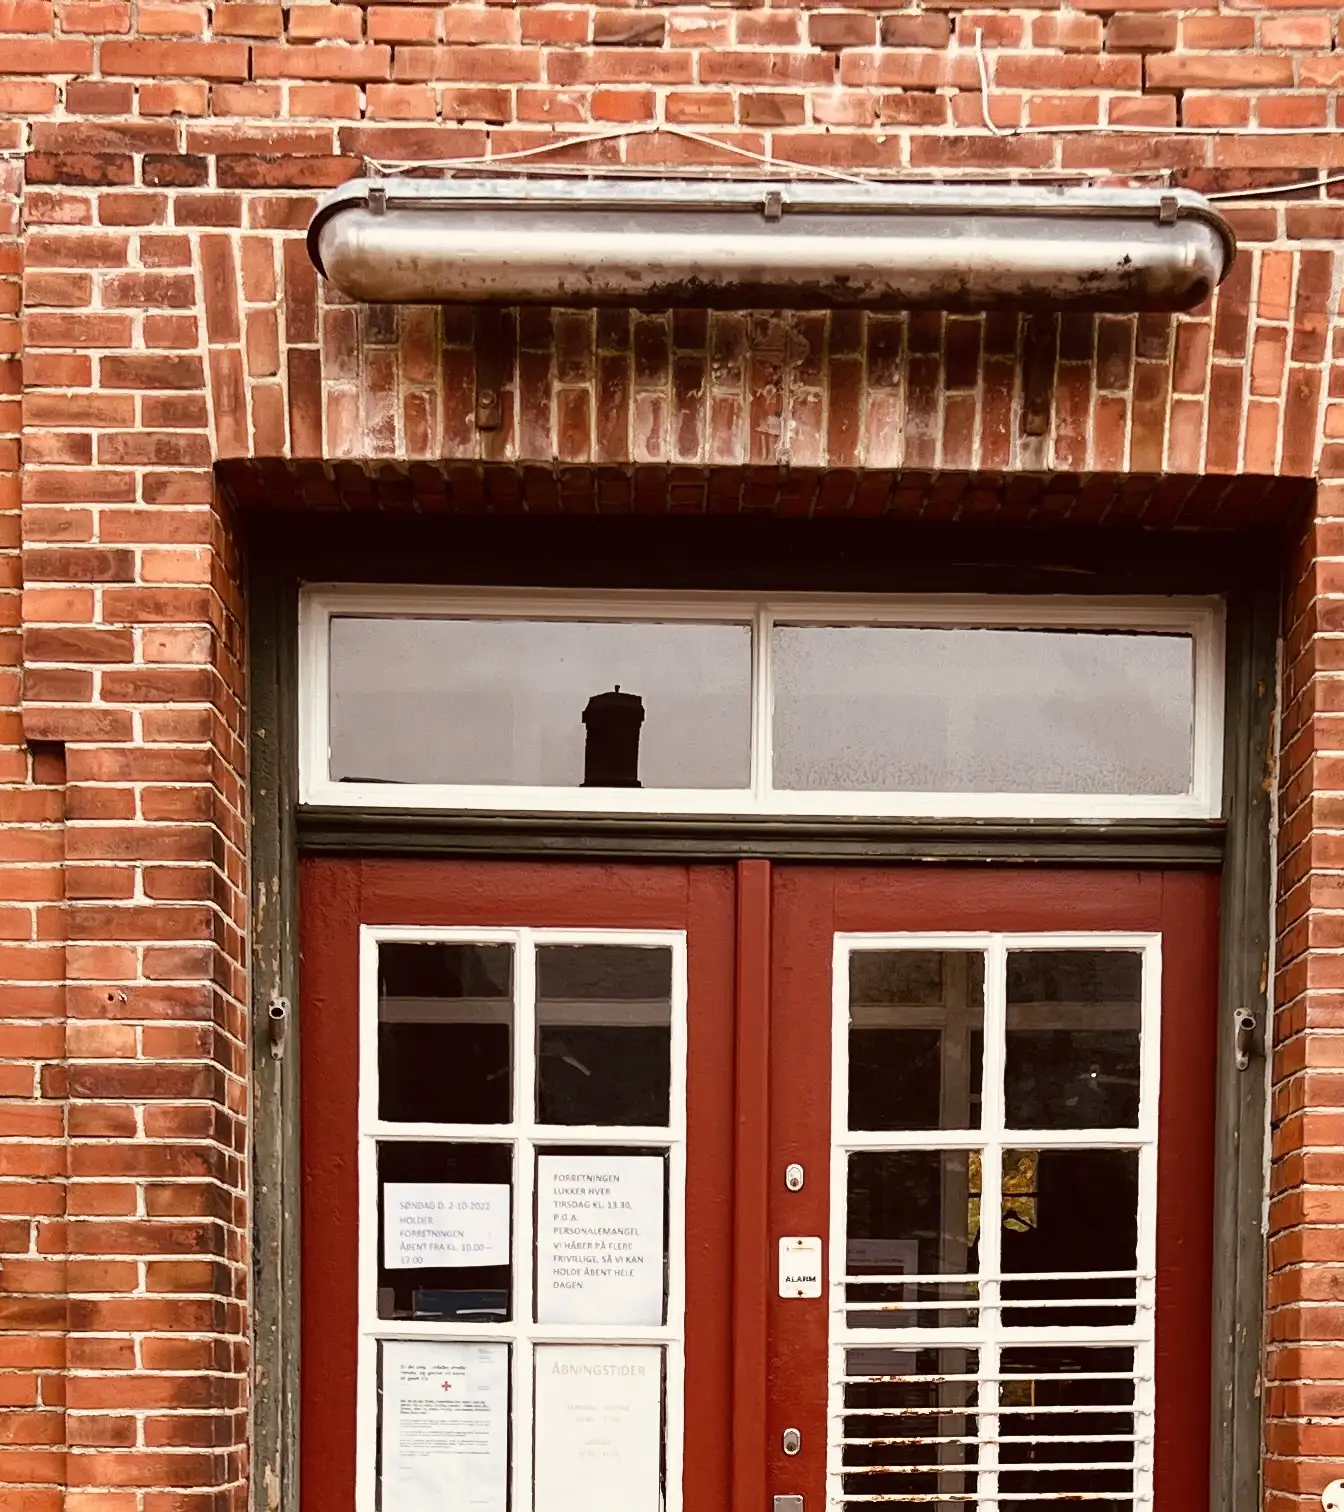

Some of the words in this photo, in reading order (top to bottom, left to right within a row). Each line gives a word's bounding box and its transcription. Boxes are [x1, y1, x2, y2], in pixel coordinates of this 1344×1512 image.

[553, 1174, 620, 1183] FORRETNINGEN
[553, 1187, 586, 1196] LUKKER
[588, 1188, 611, 1196] HVER
[399, 1201, 435, 1210] SØNDAG
[553, 1200, 590, 1209] TIRSDAG
[399, 1216, 434, 1225] HOLDER
[399, 1230, 465, 1238] FORRETNINGEN
[399, 1241, 427, 1251] ÅBENT
[429, 1244, 445, 1252] FRA
[595, 1241, 606, 1250] PÅ
[608, 1243, 633, 1251] FLERE
[601, 1254, 612, 1263] SÅ
[553, 1268, 581, 1277] HOLDE
[584, 1267, 612, 1277] ÅBENT
[614, 1269, 635, 1277] HELE
[785, 1275, 817, 1283] ALARM
[551, 1361, 646, 1378] ÅBNINGSTIDER
